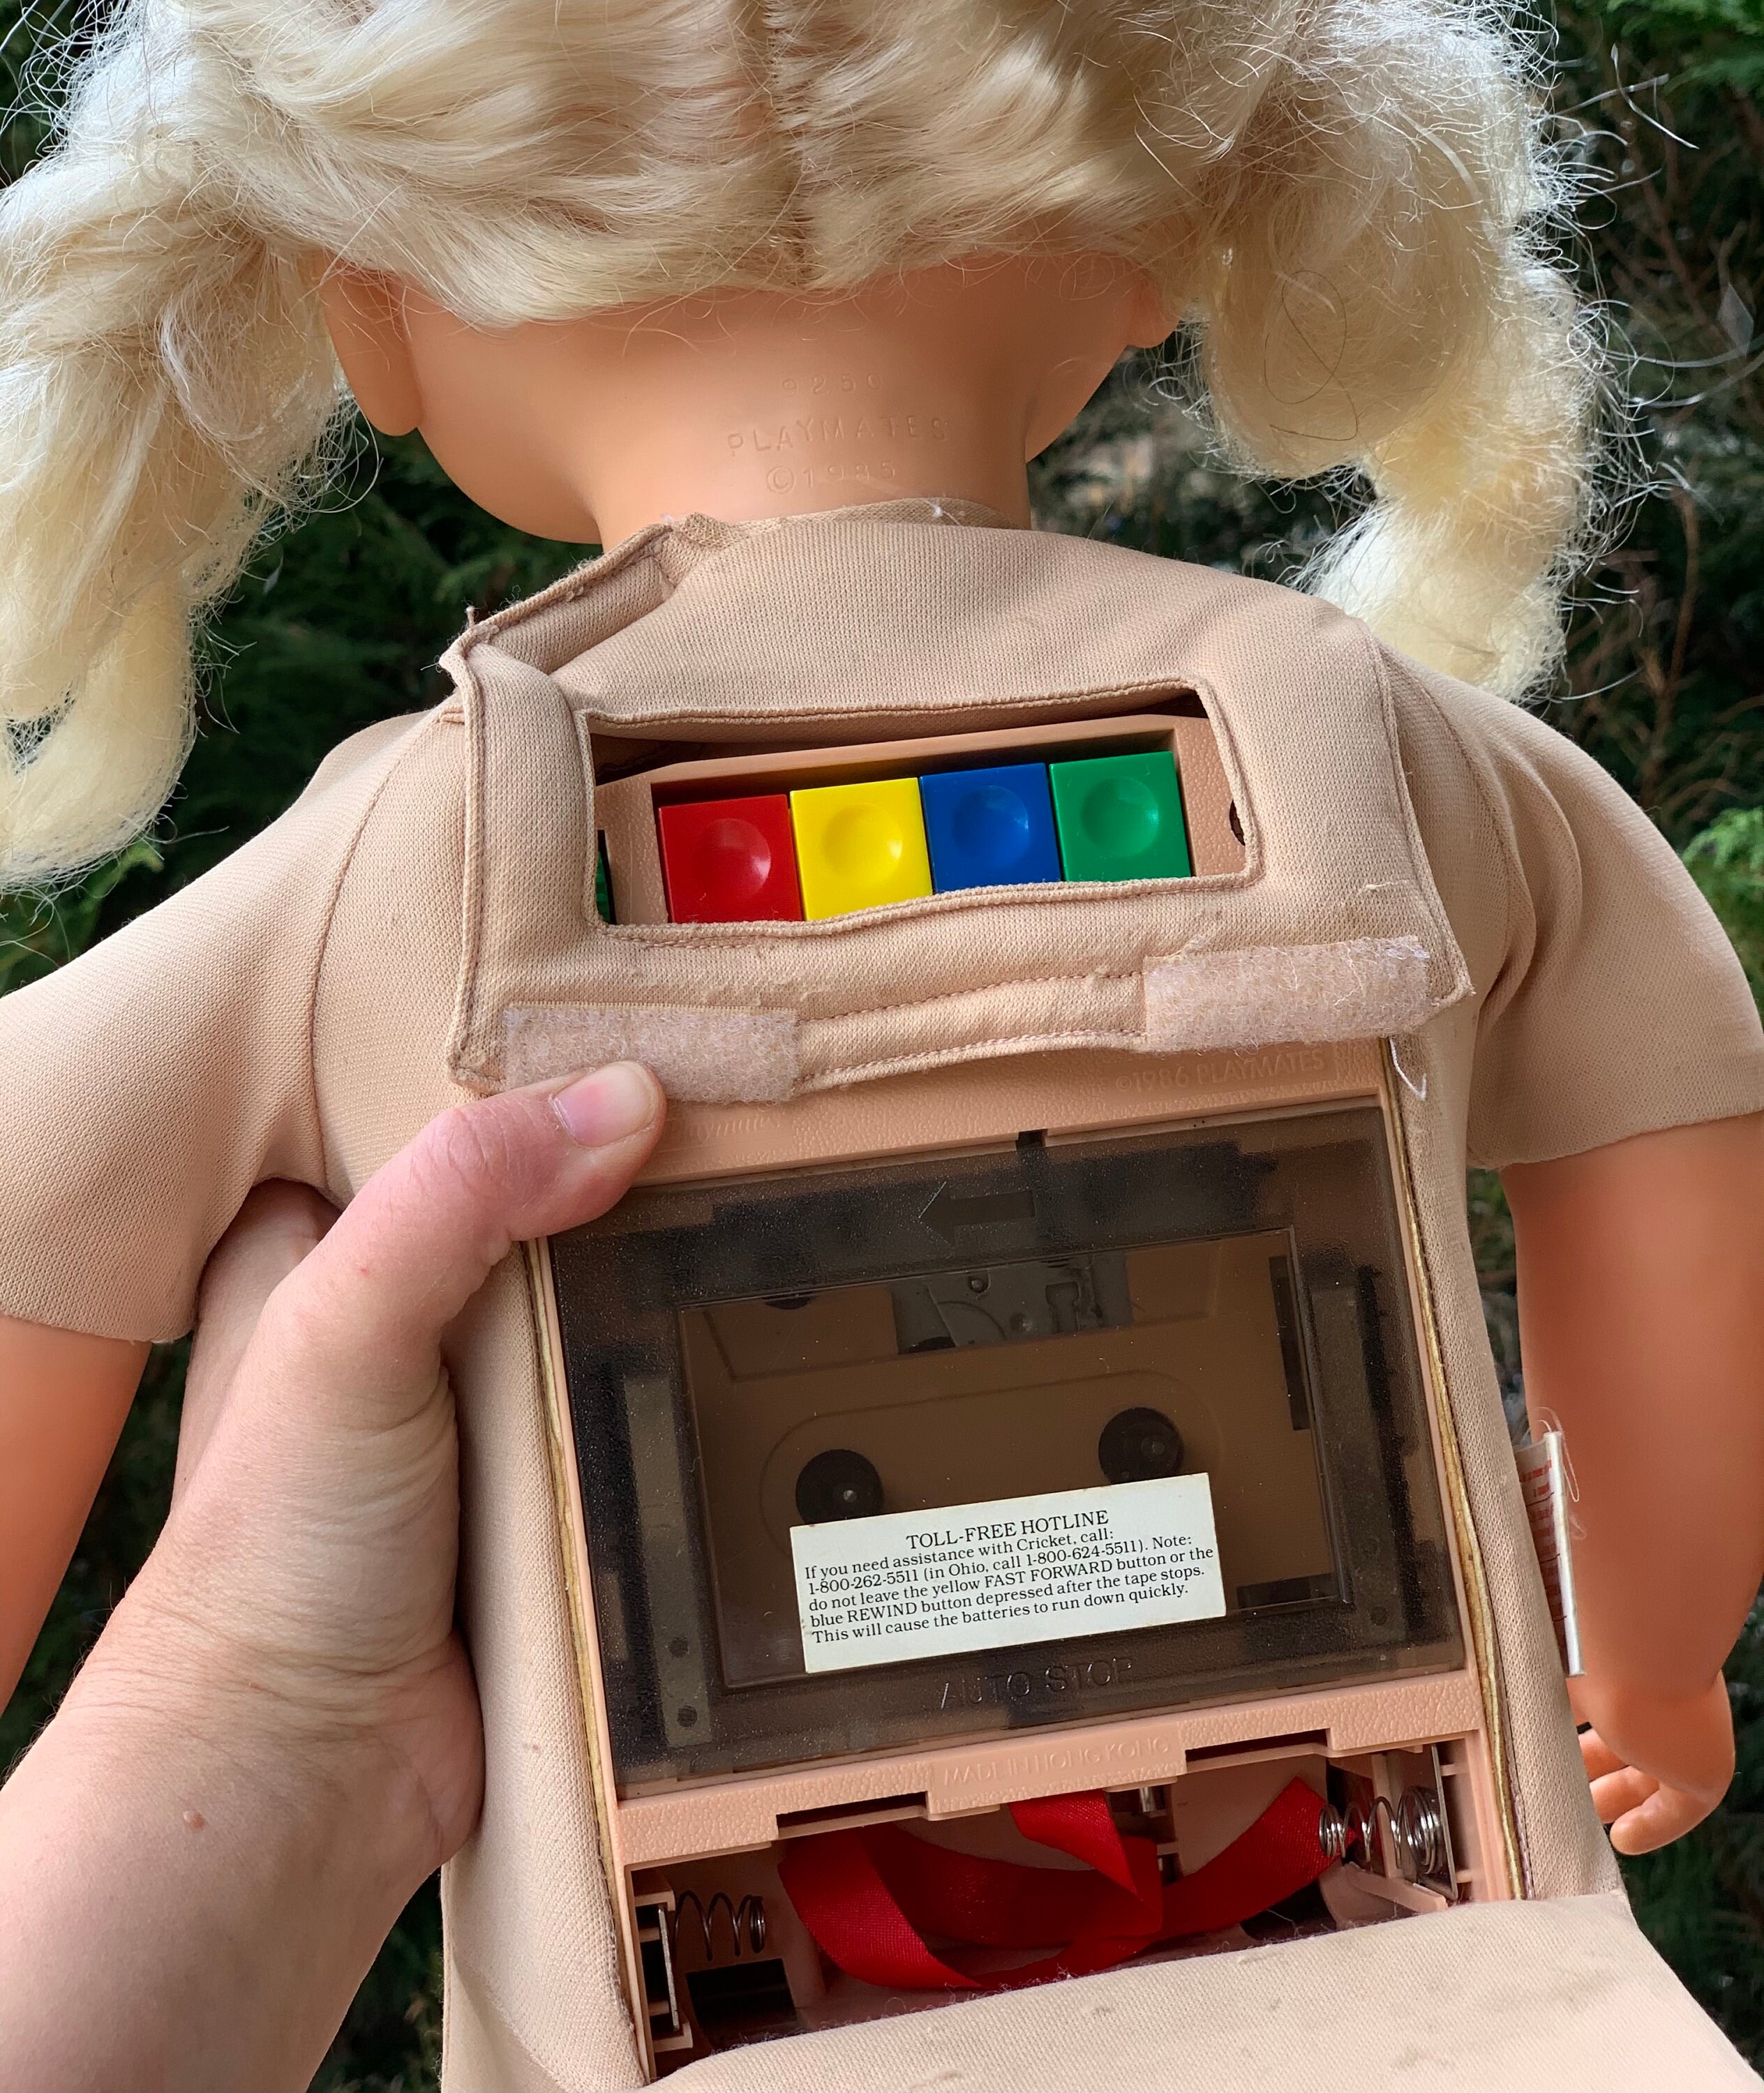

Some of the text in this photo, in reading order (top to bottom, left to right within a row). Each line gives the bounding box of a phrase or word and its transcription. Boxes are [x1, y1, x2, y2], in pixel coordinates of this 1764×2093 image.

[782, 372, 883, 397] 9250
[727, 415, 947, 456] PLAYMATES
[1196, 1048, 1326, 1085] PLAYMATES
[805, 1526, 1114, 1582] If you need assistance with Cricket, call:
[905, 1510, 1109, 1550] TOLL-FREE HOTLINE
[808, 1536, 1192, 1596] 1-800-262-5511 (in Ohio, call 1-800-624-5511). Note:
[809, 1547, 1214, 1612] do not leave the yellow FAST FORWARD button or the
[809, 1566, 1205, 1628] blue REWIND button depressed after the tape stops.
[811, 1582, 1188, 1644] This will cause the batteries to run down quickly.
[940, 1658, 1133, 1709] AUTO STOP
[943, 1736, 1169, 1787] MADE IN HONG KONG
